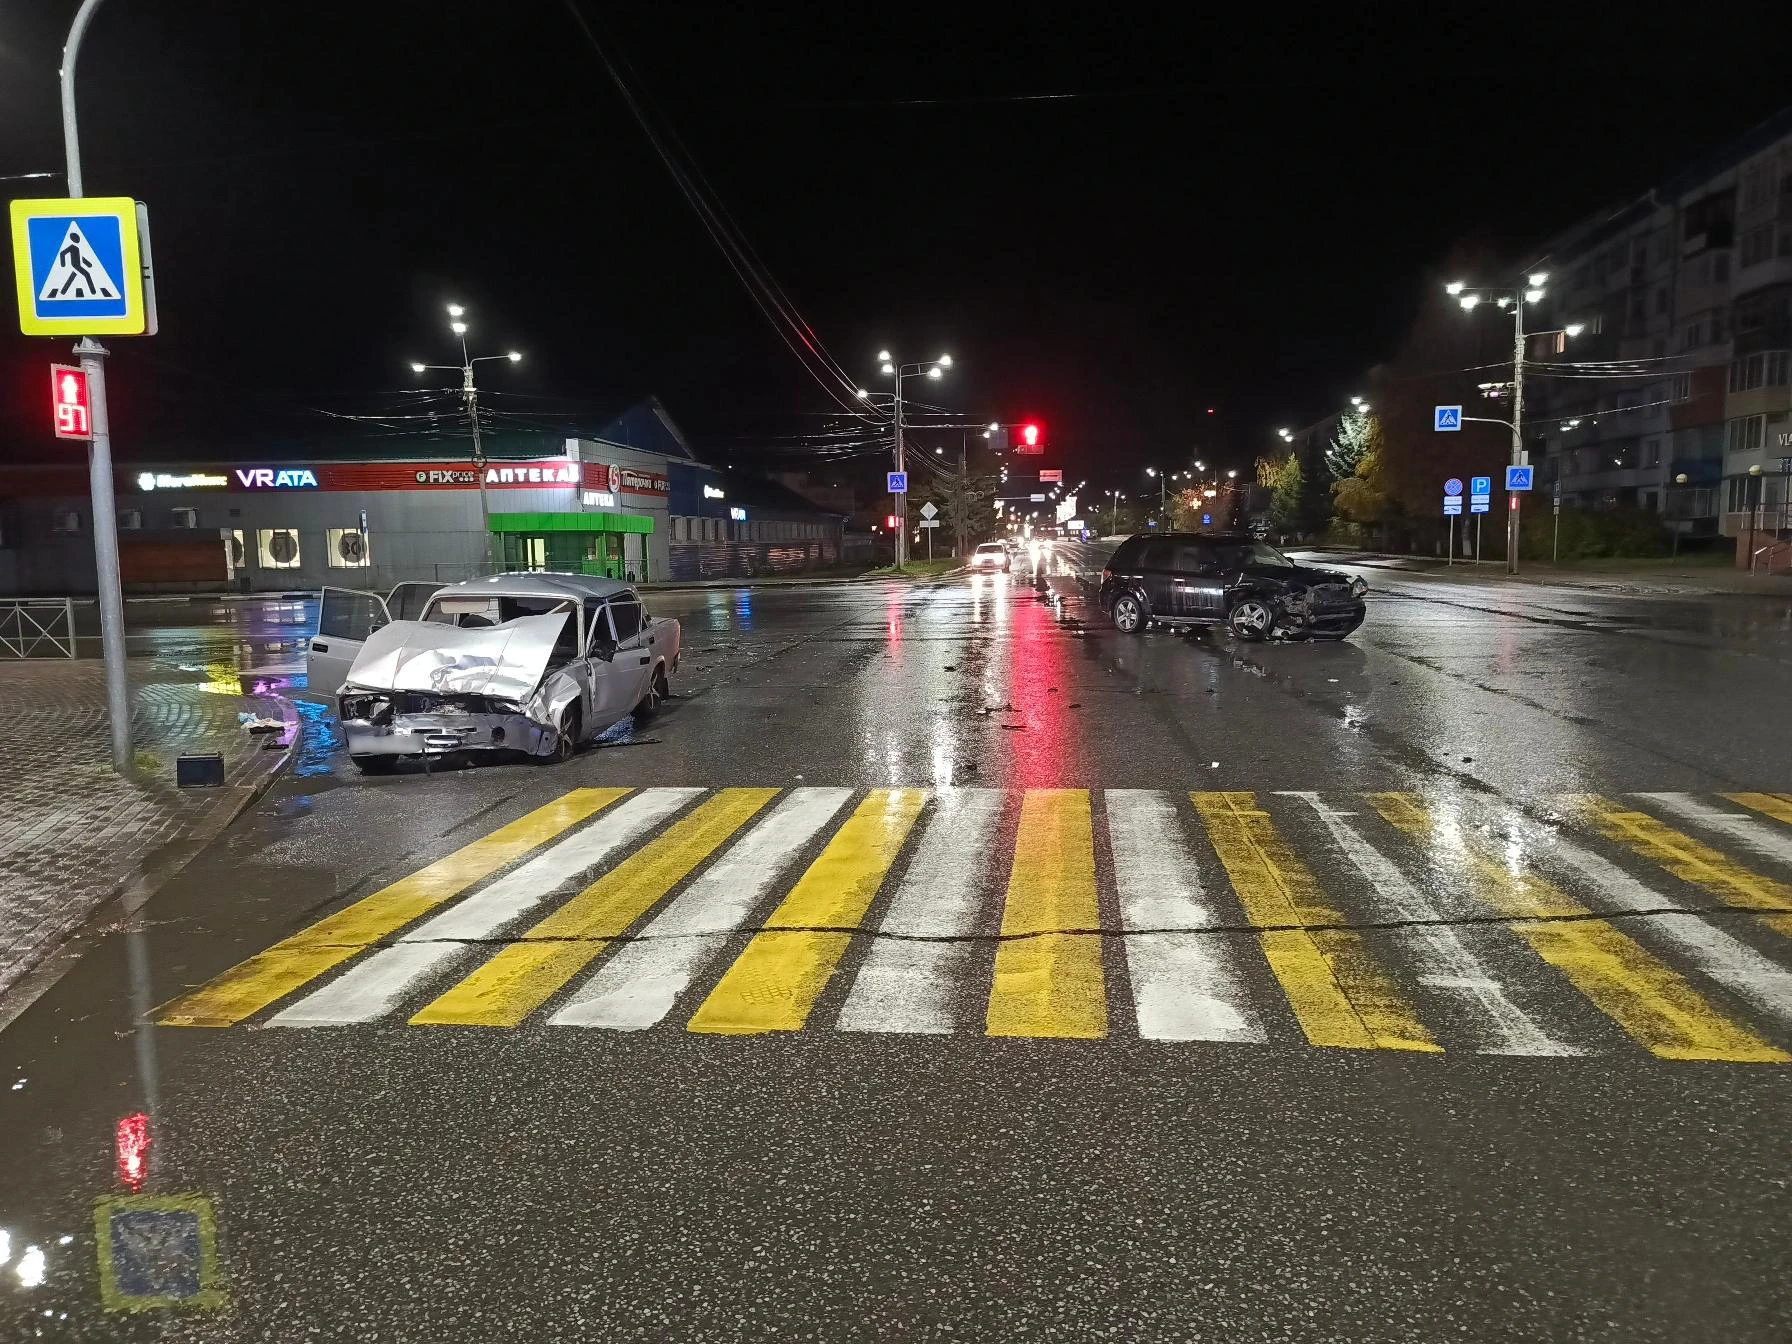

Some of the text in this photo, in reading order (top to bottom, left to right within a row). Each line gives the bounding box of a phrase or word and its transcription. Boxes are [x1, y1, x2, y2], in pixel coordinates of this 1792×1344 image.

[58, 403, 87, 432] 97
[235, 469, 317, 487] VRATA
[486, 467, 573, 483] АПТЕКА
[1476, 479, 1487, 492] P
[583, 492, 614, 507] АПТЕКА
